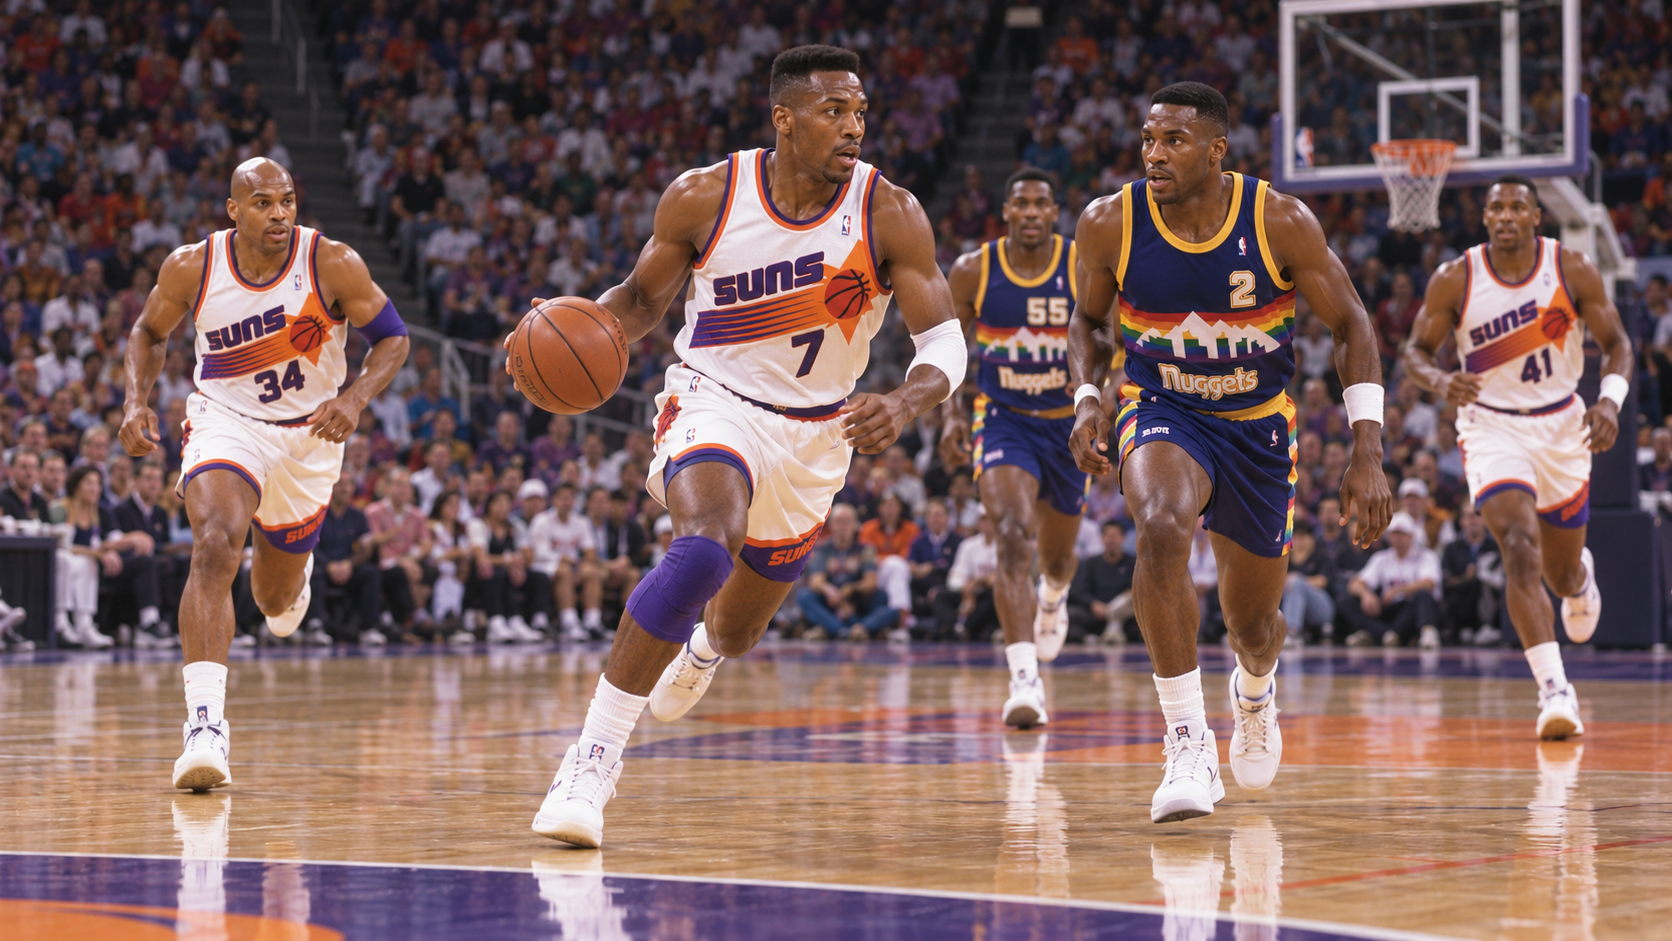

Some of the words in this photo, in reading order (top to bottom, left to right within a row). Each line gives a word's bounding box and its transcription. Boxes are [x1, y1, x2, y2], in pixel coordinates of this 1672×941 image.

[713, 251, 825, 306] SUNS
[1229, 270, 1256, 309] 2
[205, 304, 286, 351] SUNS
[1027, 297, 1069, 326] 55
[1469, 299, 1538, 347] SUNS
[791, 328, 825, 378] 7
[1521, 347, 1553, 384] 41
[254, 359, 305, 404] 34
[998, 365, 1067, 395] Nuggets
[1158, 363, 1258, 400] Nuggets
